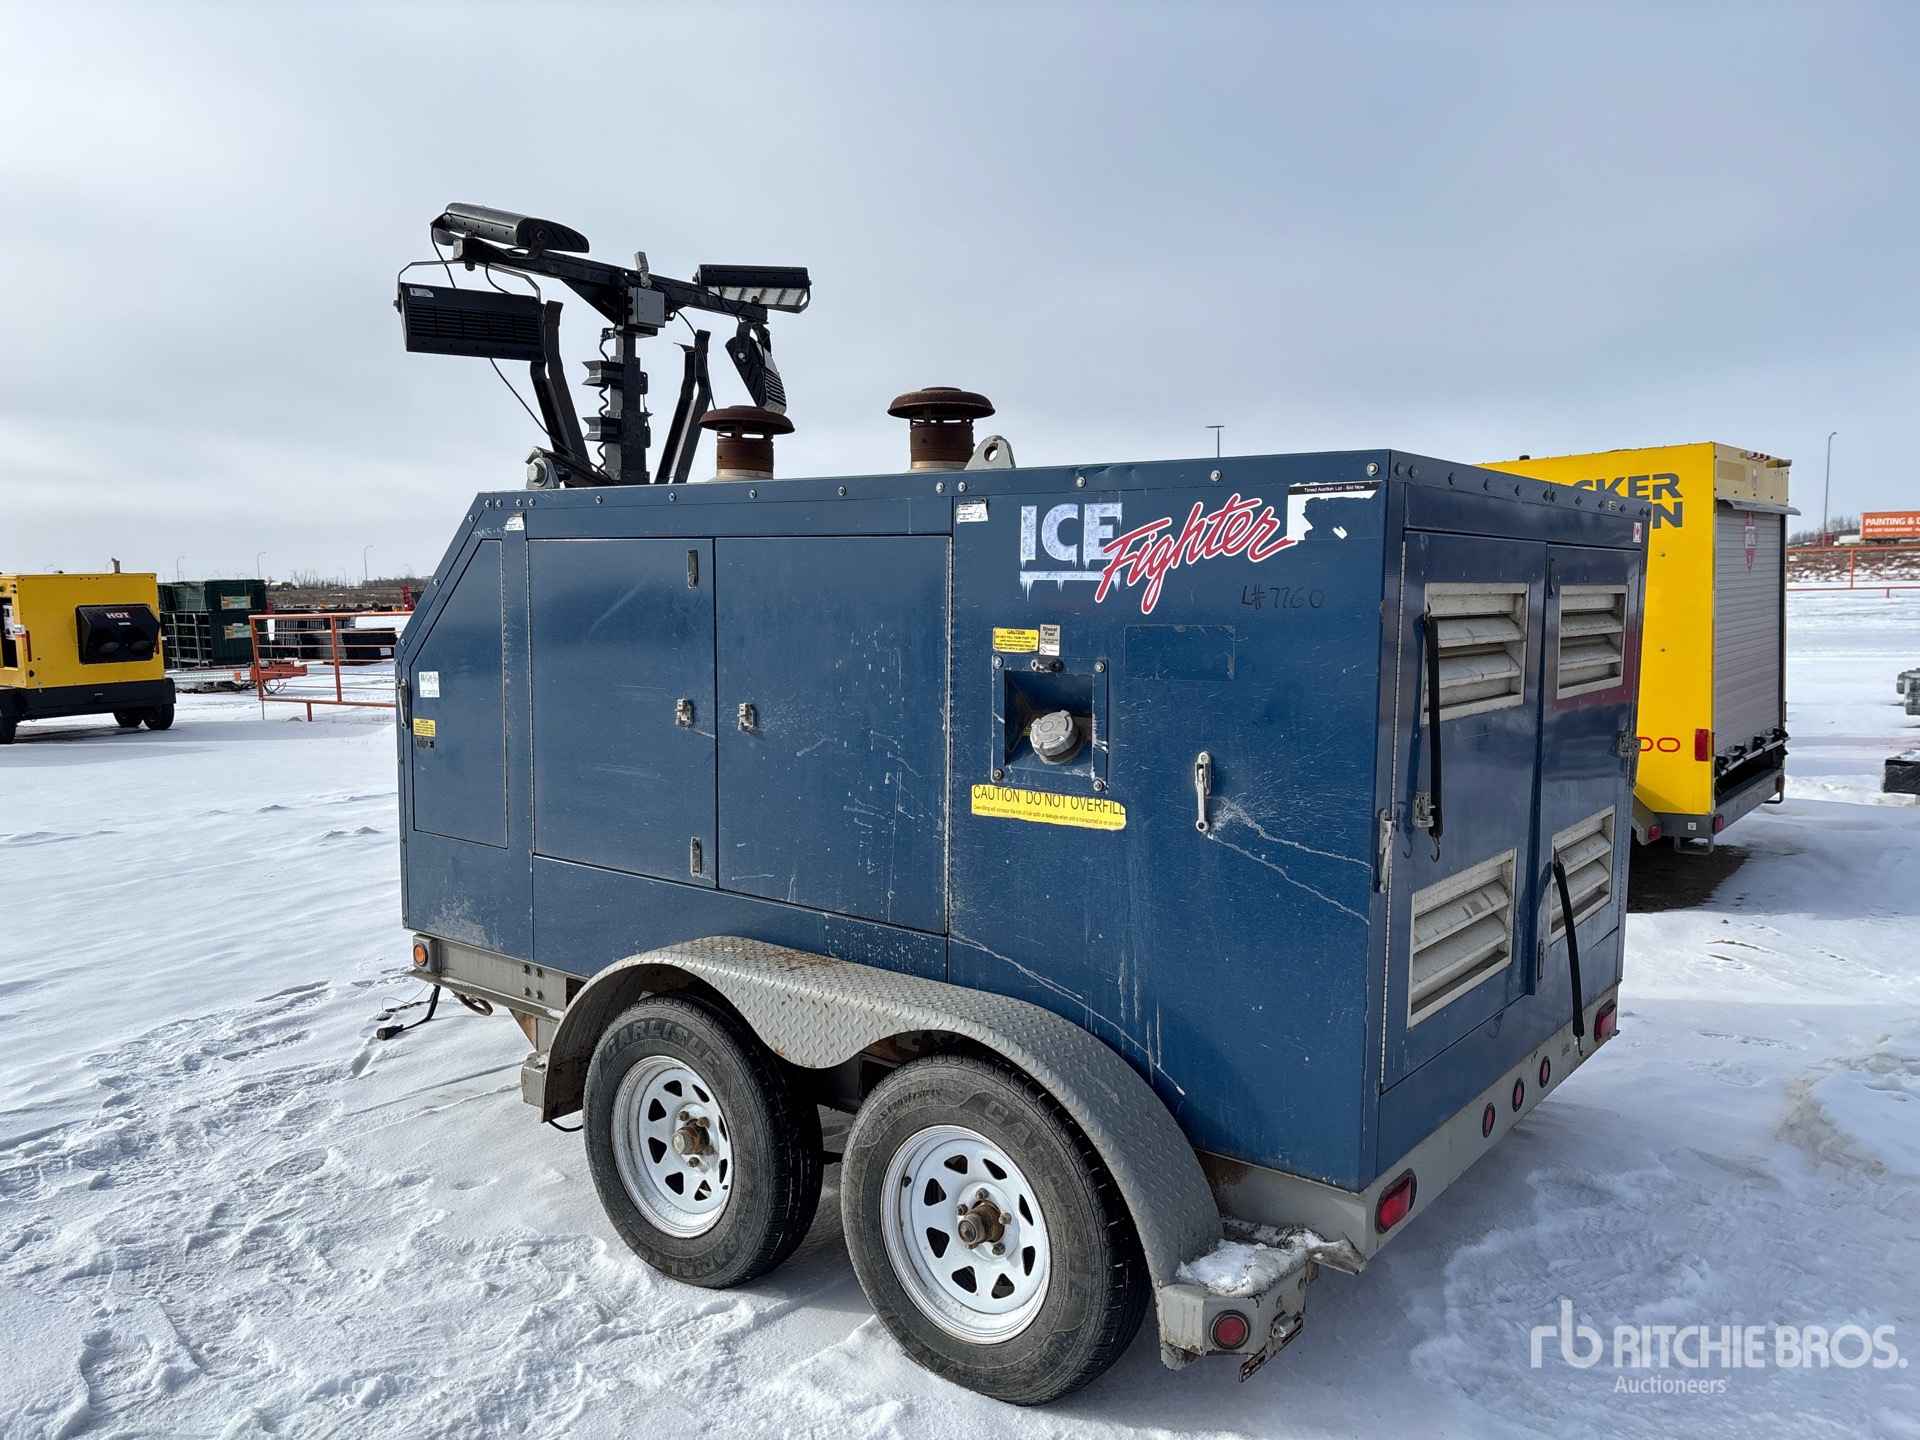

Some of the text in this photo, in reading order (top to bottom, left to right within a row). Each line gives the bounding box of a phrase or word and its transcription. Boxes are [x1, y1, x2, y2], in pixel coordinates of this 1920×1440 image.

[1019, 501, 1124, 568] ICE
[1865, 517, 1906, 526] PAINTING
[1907, 516, 1915, 525] &
[1094, 492, 1300, 616] Fighter
[973, 785, 1126, 816] CAUTION DO NOT OVERFILL
[605, 1020, 722, 1074] CARLISLE
